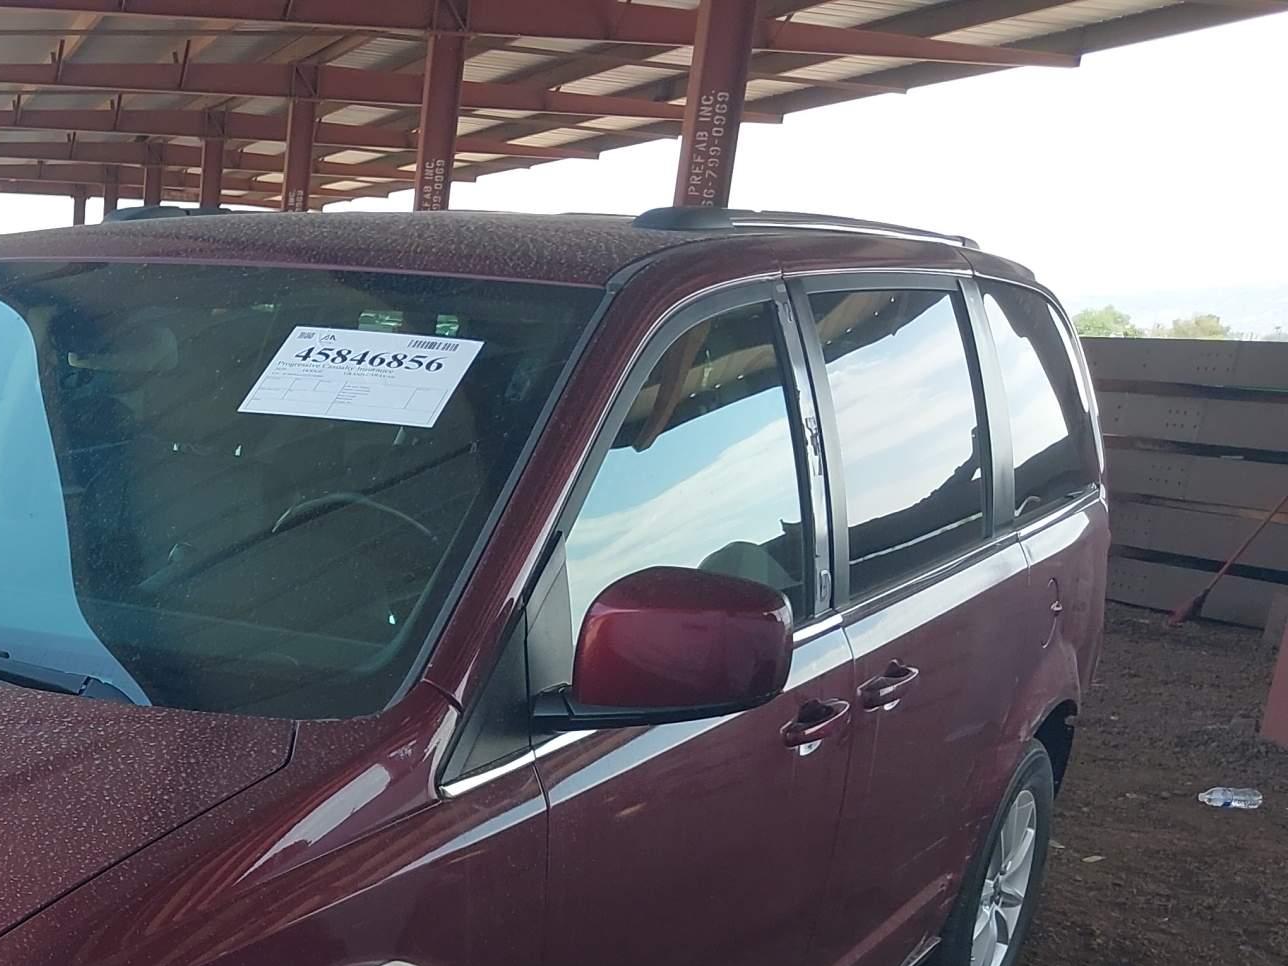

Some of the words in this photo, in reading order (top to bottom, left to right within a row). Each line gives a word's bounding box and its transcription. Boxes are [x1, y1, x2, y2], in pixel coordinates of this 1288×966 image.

[687, 131, 710, 196] PREFAB
[699, 89, 715, 121] INC.
[295, 346, 448, 373] 45846856
